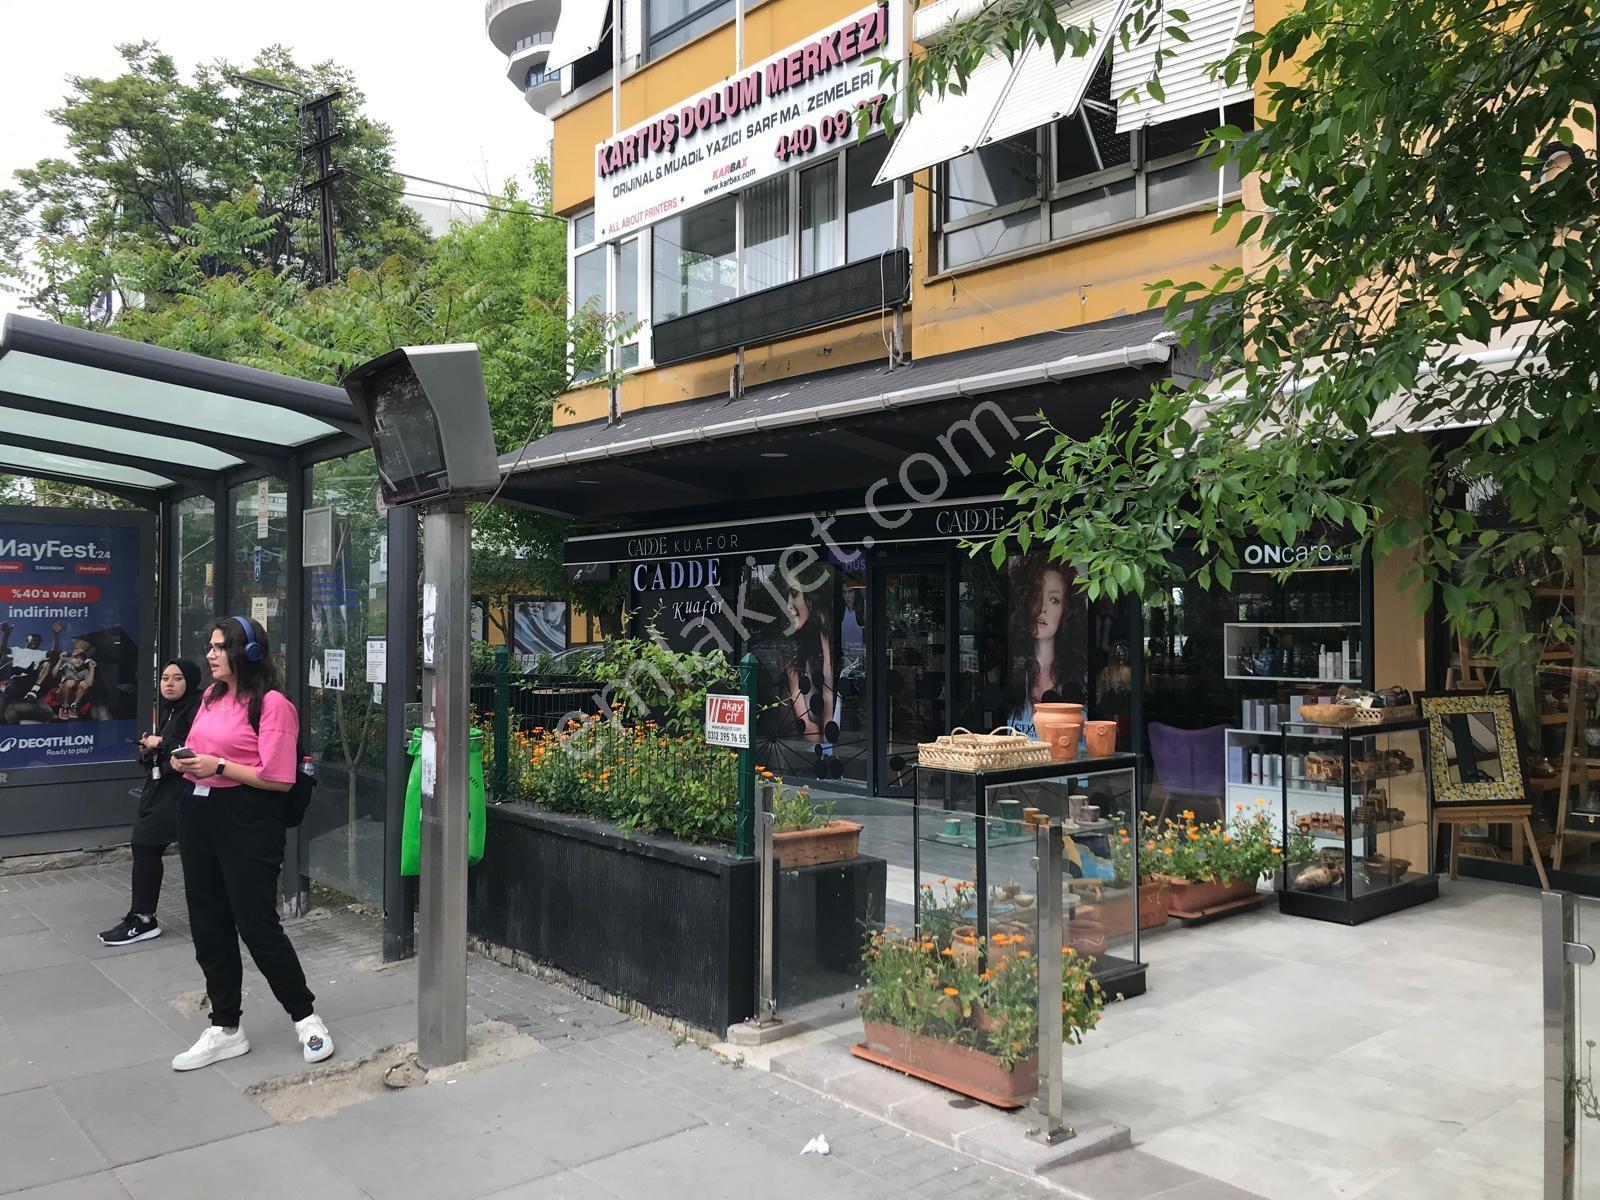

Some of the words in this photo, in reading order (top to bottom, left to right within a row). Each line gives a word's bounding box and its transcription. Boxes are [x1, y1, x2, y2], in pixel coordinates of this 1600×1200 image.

[598, 113, 679, 178] KARTUŞ
[680, 71, 762, 138] DOLUM
[774, 124, 817, 162] 440
[819, 108, 852, 144] 09
[655, 166, 663, 180] &
[706, 129, 742, 158] YAZICI
[712, 156, 749, 181] KARBAX
[608, 220, 621, 235] ALL
[622, 212, 644, 229] ABOUT
[644, 197, 678, 220] PRINTERS
[936, 507, 1005, 534] CADDE
[628, 536, 668, 557] CADDE
[674, 534, 738, 553] KUAFÖR
[633, 558, 721, 591] CADDE
[52, 591, 87, 599] varan
[8, 605, 89, 618] indirimler!
[18, 735, 94, 749] DECATHLON
[739, 734, 747, 743] 55
